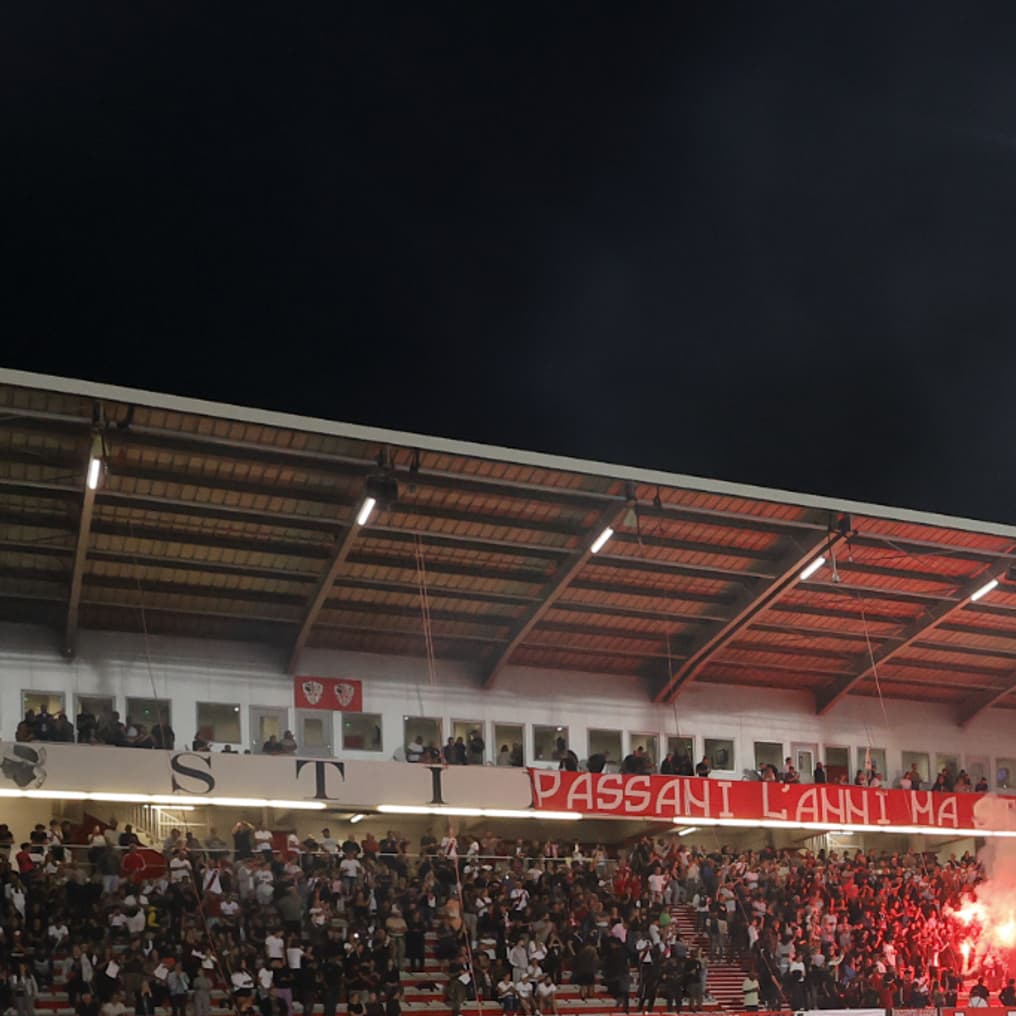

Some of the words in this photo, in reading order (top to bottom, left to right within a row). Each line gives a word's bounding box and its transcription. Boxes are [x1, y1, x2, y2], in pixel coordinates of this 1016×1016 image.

[533, 769, 735, 818] PASSANI
[762, 781, 891, 825] L'ANNI
[911, 790, 958, 828] MA
